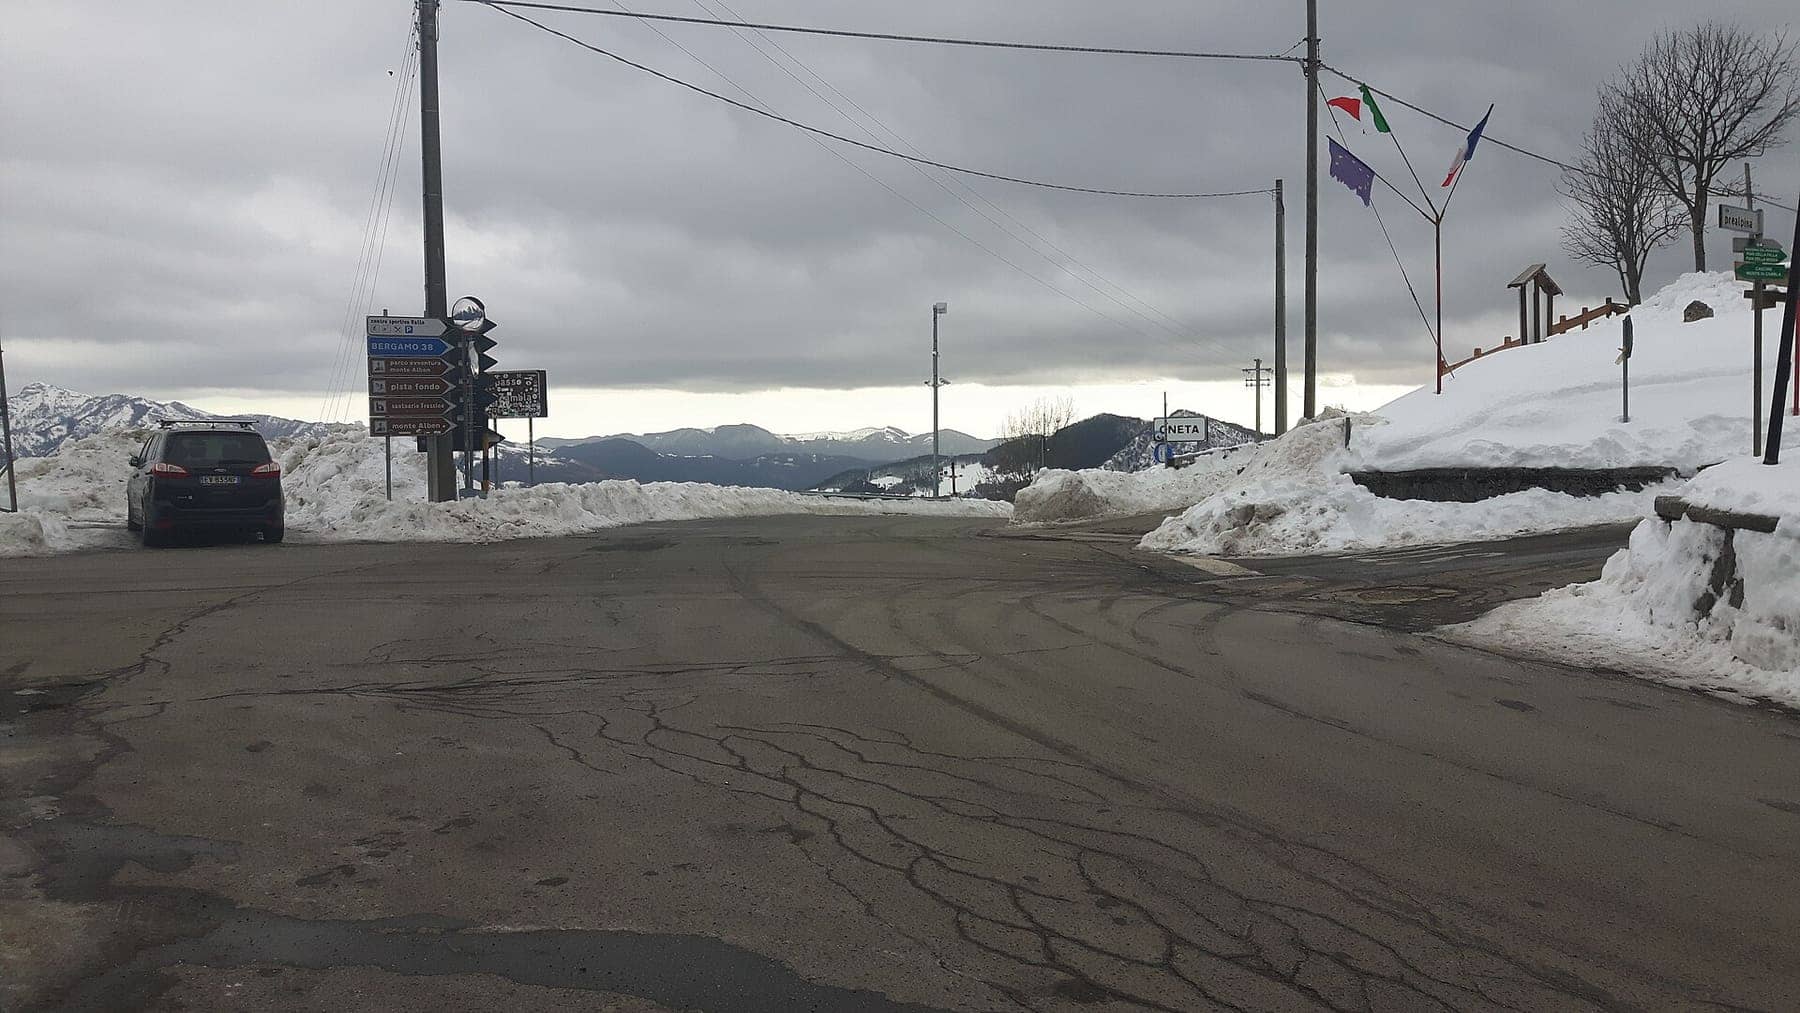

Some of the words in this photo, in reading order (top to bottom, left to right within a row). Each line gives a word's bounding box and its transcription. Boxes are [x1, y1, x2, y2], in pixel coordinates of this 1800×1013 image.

[371, 342, 419, 351] BERGAMO
[421, 343, 434, 351] 38
[390, 383, 412, 391] pista
